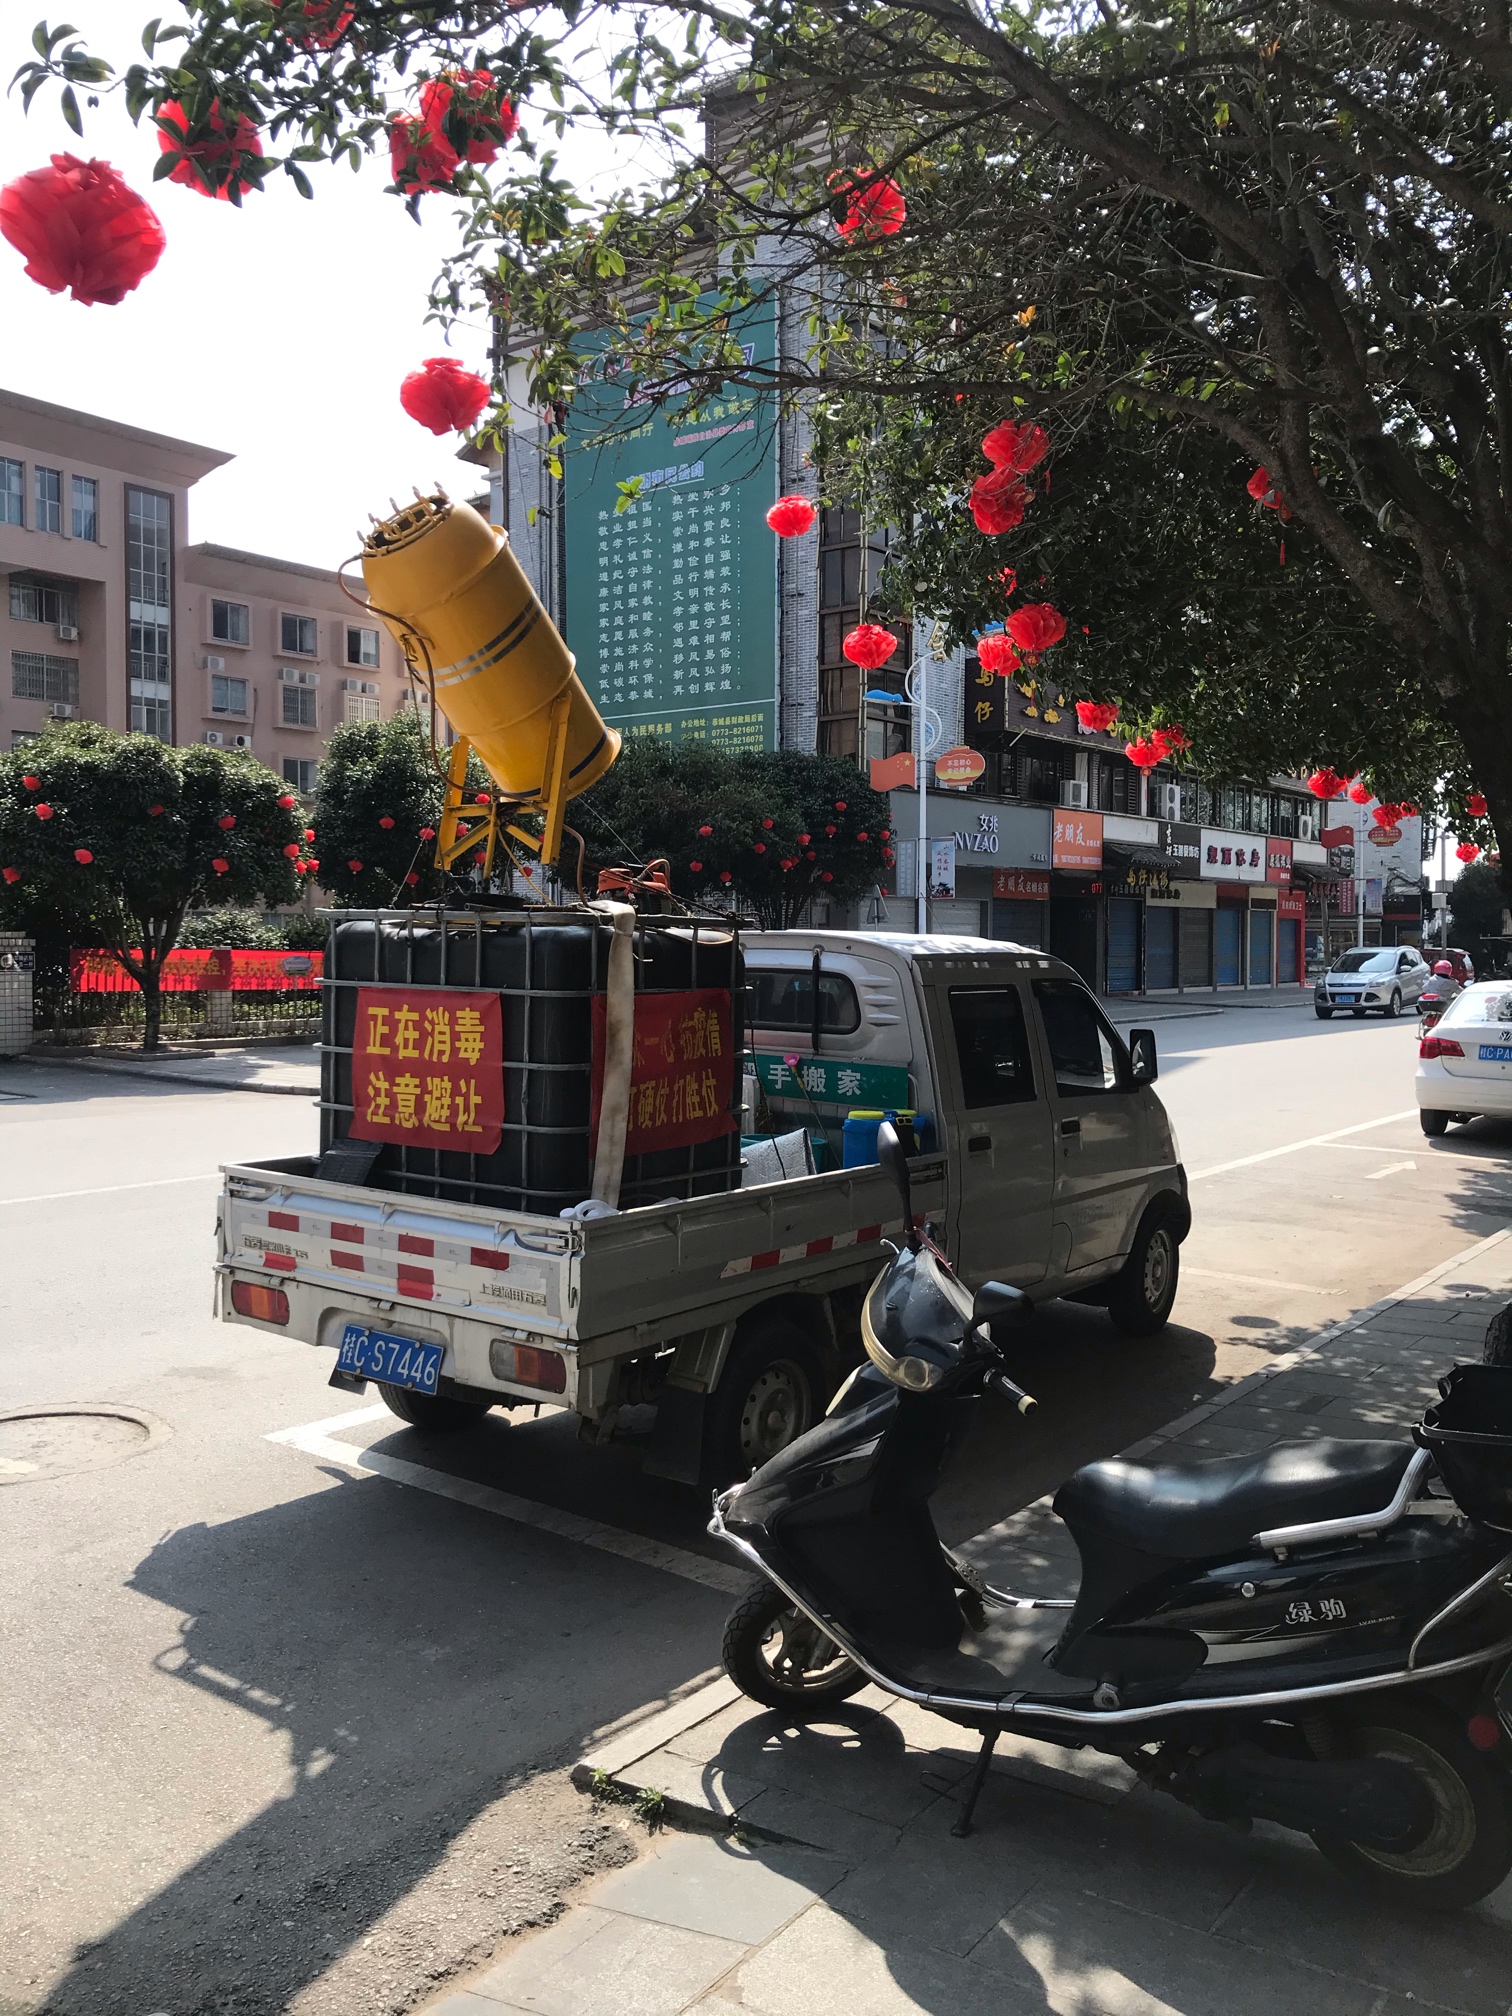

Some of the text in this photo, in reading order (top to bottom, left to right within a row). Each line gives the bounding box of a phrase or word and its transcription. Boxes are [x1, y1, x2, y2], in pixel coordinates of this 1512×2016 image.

[954, 831, 999, 854] NVZAO
[366, 1004, 485, 1065] 正在消毒
[367, 1071, 483, 1132] 注意避让
[1285, 1598, 1347, 1625] 绿驹
